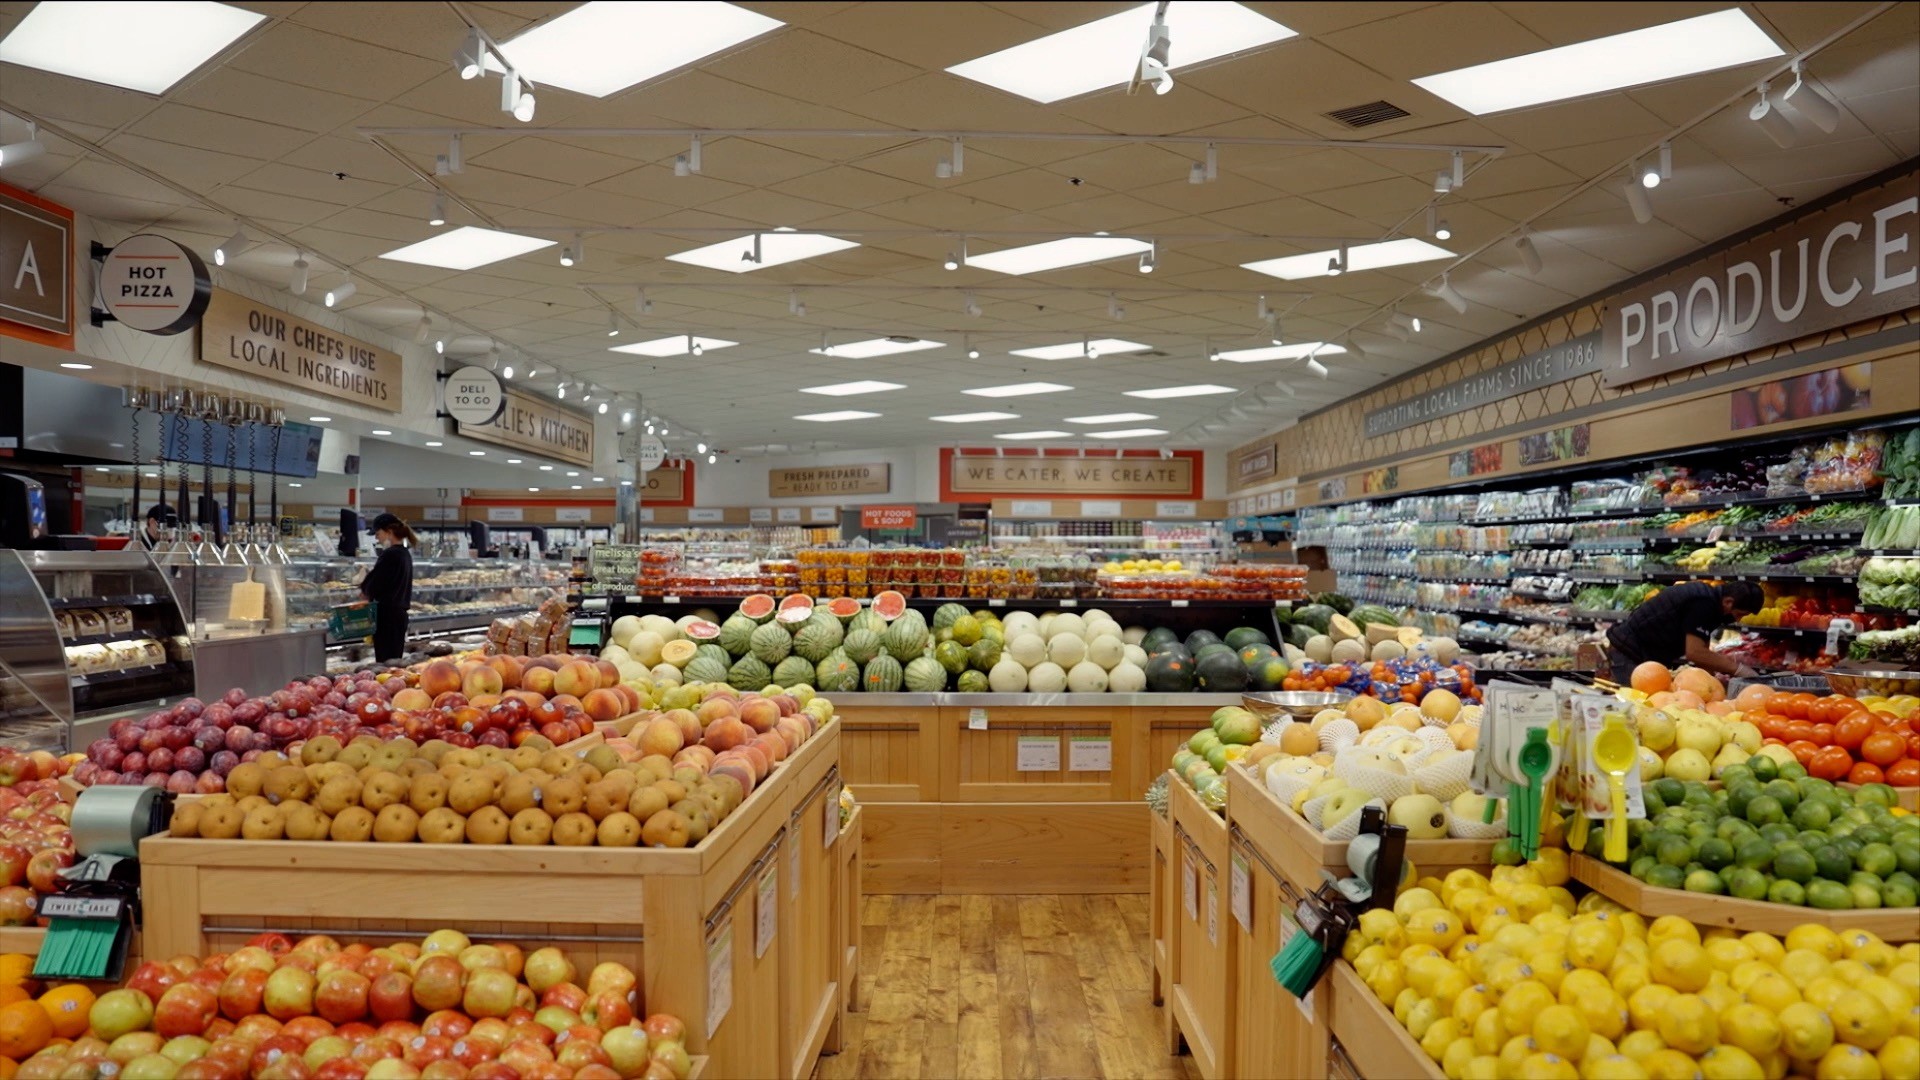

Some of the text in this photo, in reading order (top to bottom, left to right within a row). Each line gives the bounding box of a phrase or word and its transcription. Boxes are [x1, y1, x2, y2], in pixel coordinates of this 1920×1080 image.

[129, 267, 167, 279] HOT
[1620, 197, 1919, 368] PRODUCE
[121, 285, 173, 298] PIZZA
[249, 310, 376, 372] OUR CHEFS USE
[230, 335, 387, 401] LOCAL INGREDIENTS
[460, 385, 486, 394] DELI
[1368, 341, 1595, 432] SUPPORTING LOCAL FARMS SINCE 1986
[455, 396, 491, 405] TO GO
[540, 416, 589, 453] KITCHEN
[784, 467, 870, 482] FRESH PREPARED
[968, 467, 1178, 483] WE CATER, WE CREATE
[793, 479, 860, 493] READY TO EAT
[865, 510, 912, 518] HOT FOODS
[595, 549, 640, 558] melissa's
[593, 565, 637, 575] great book
[592, 581, 636, 593] of produce
[50, 904, 110, 912] TWIST EASE
